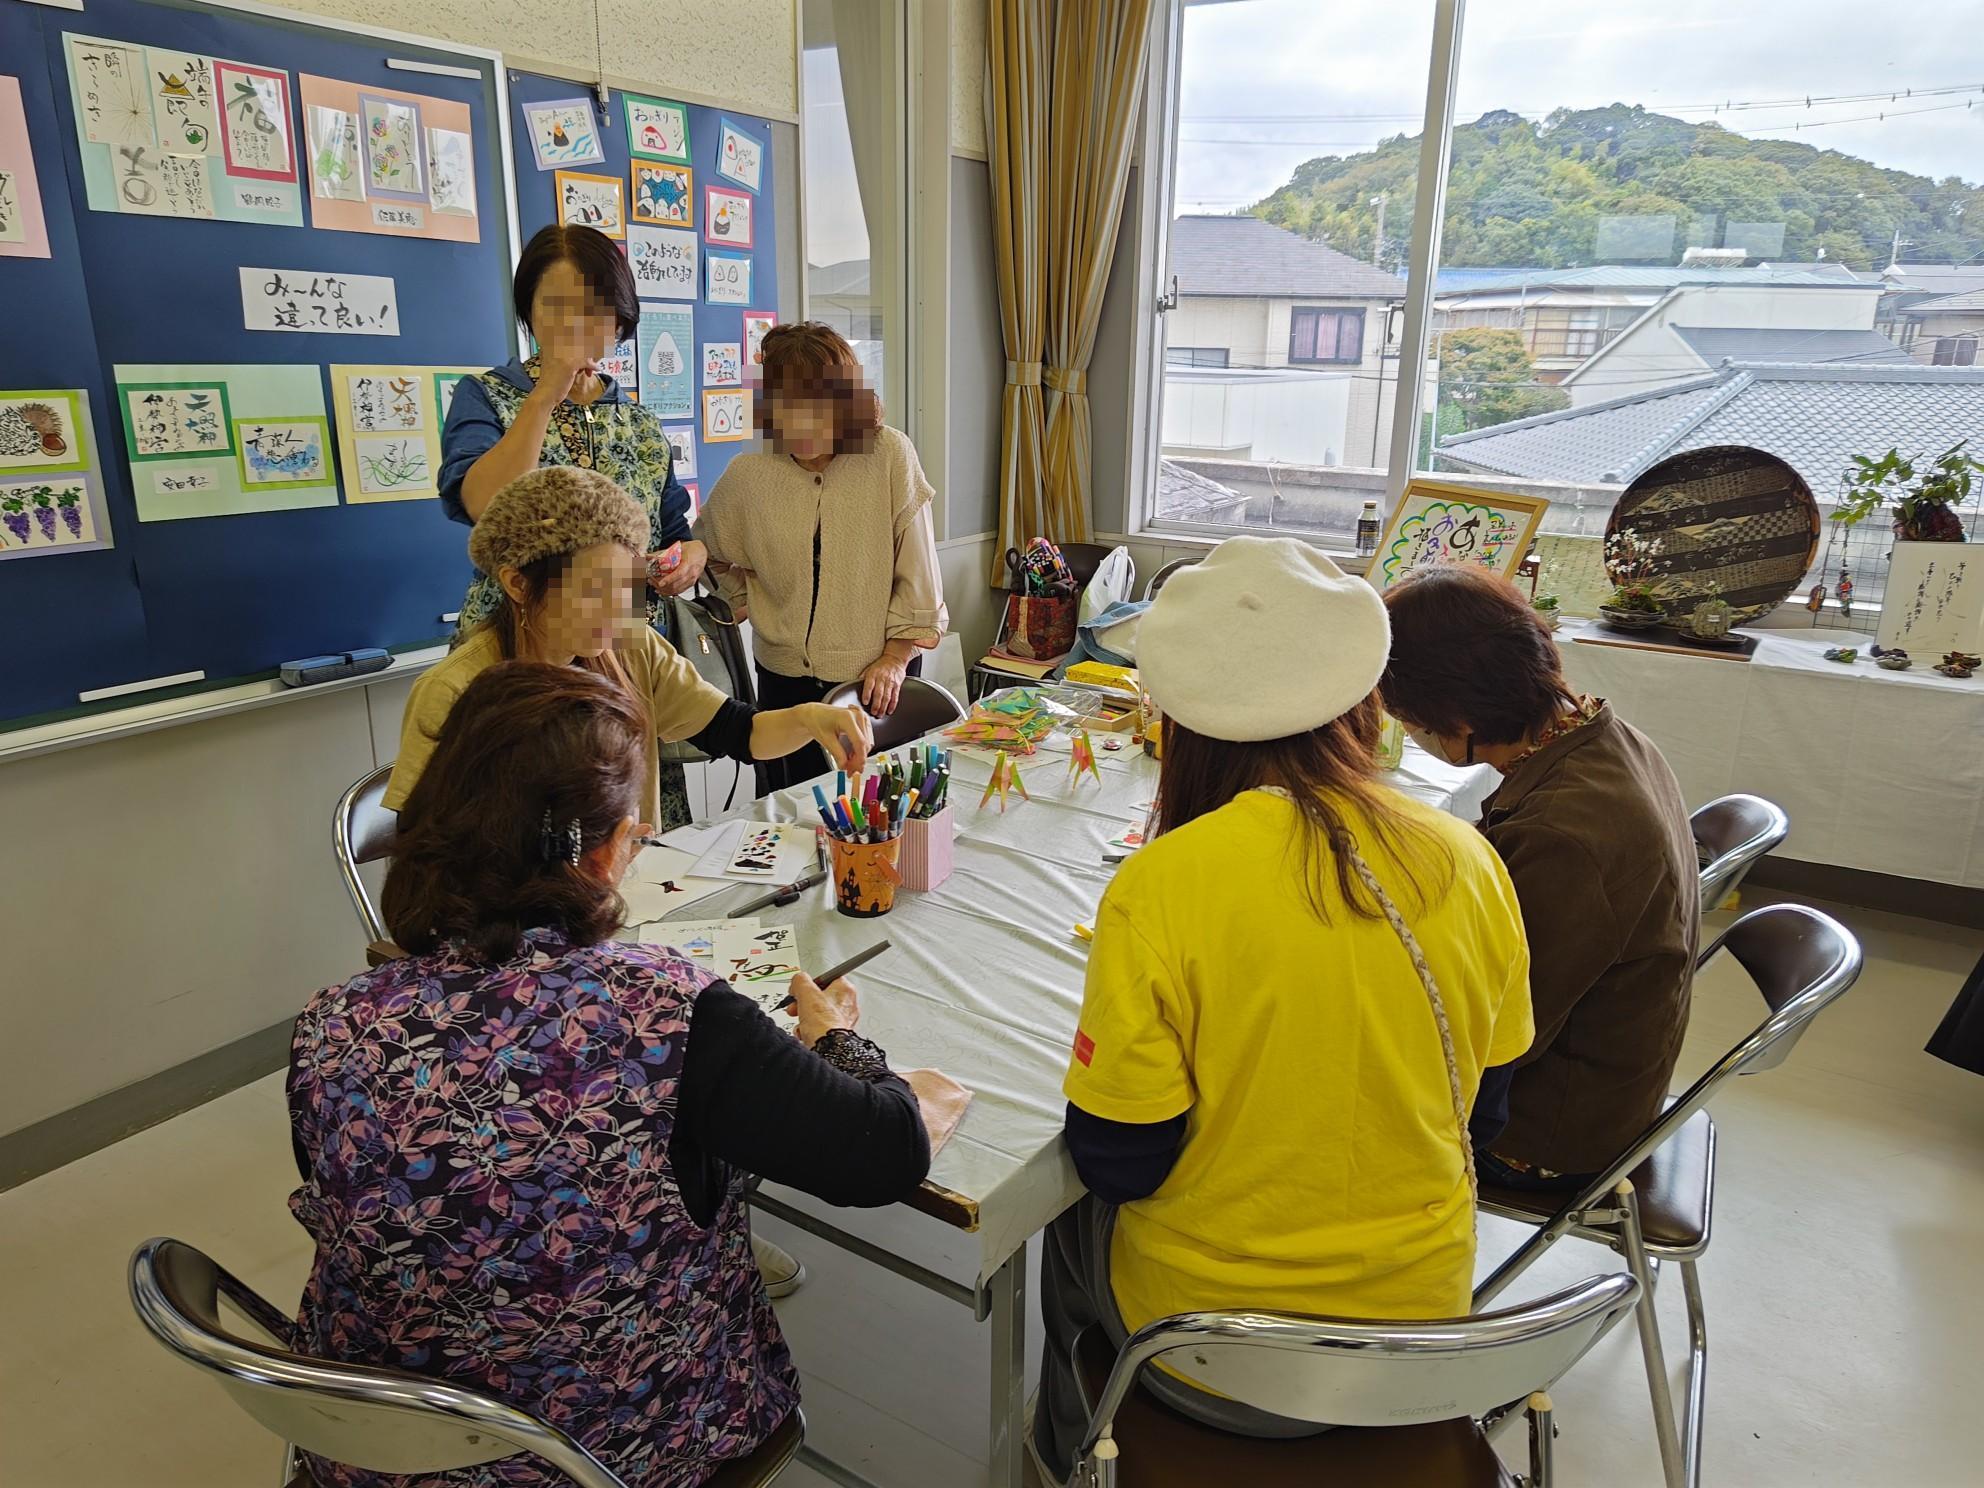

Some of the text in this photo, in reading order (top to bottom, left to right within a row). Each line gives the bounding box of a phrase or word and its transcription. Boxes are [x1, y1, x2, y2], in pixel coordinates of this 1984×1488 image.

[645, 241, 682, 259] このような
